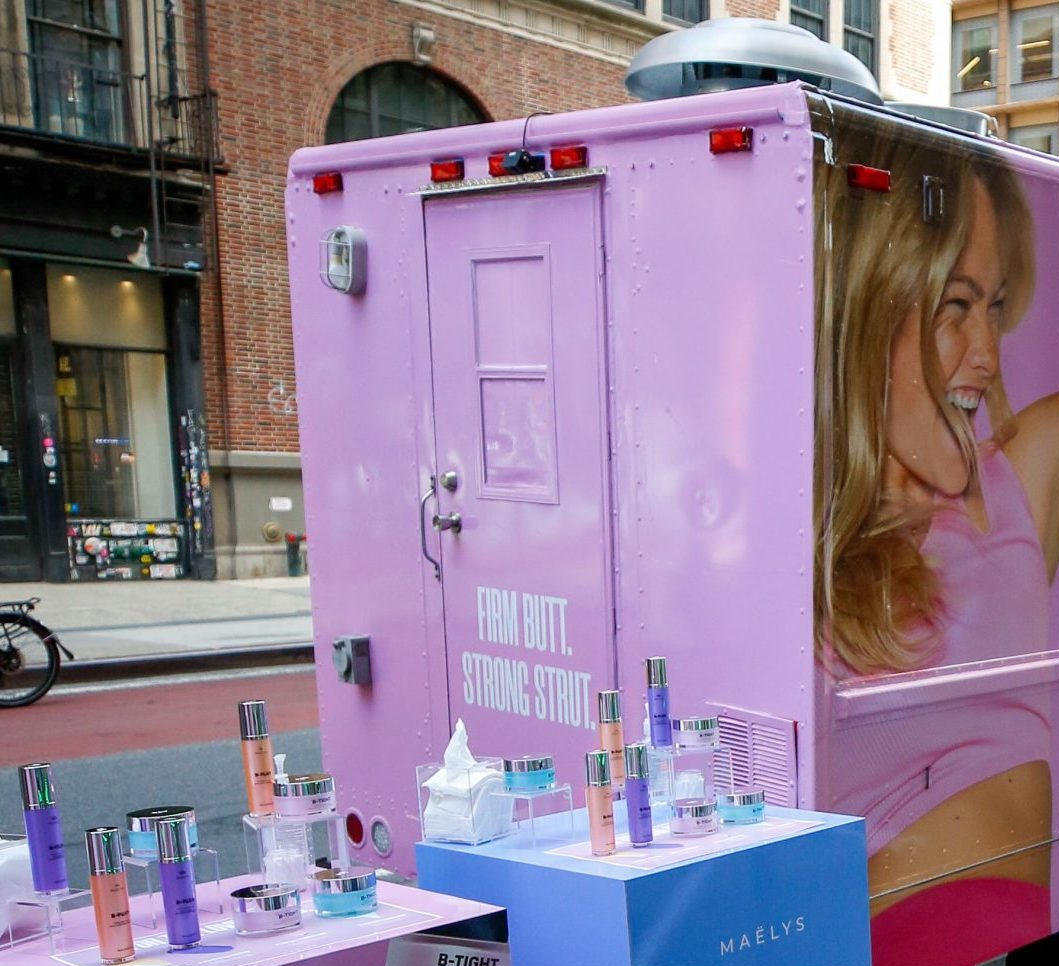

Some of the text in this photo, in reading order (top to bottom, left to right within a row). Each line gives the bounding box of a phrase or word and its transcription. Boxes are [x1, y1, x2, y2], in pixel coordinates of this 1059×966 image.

[477, 586, 573, 656] FIRM BUTT.
[462, 651, 596, 730] STRONG STRUT.
[720, 916, 804, 956] MAËLYS
